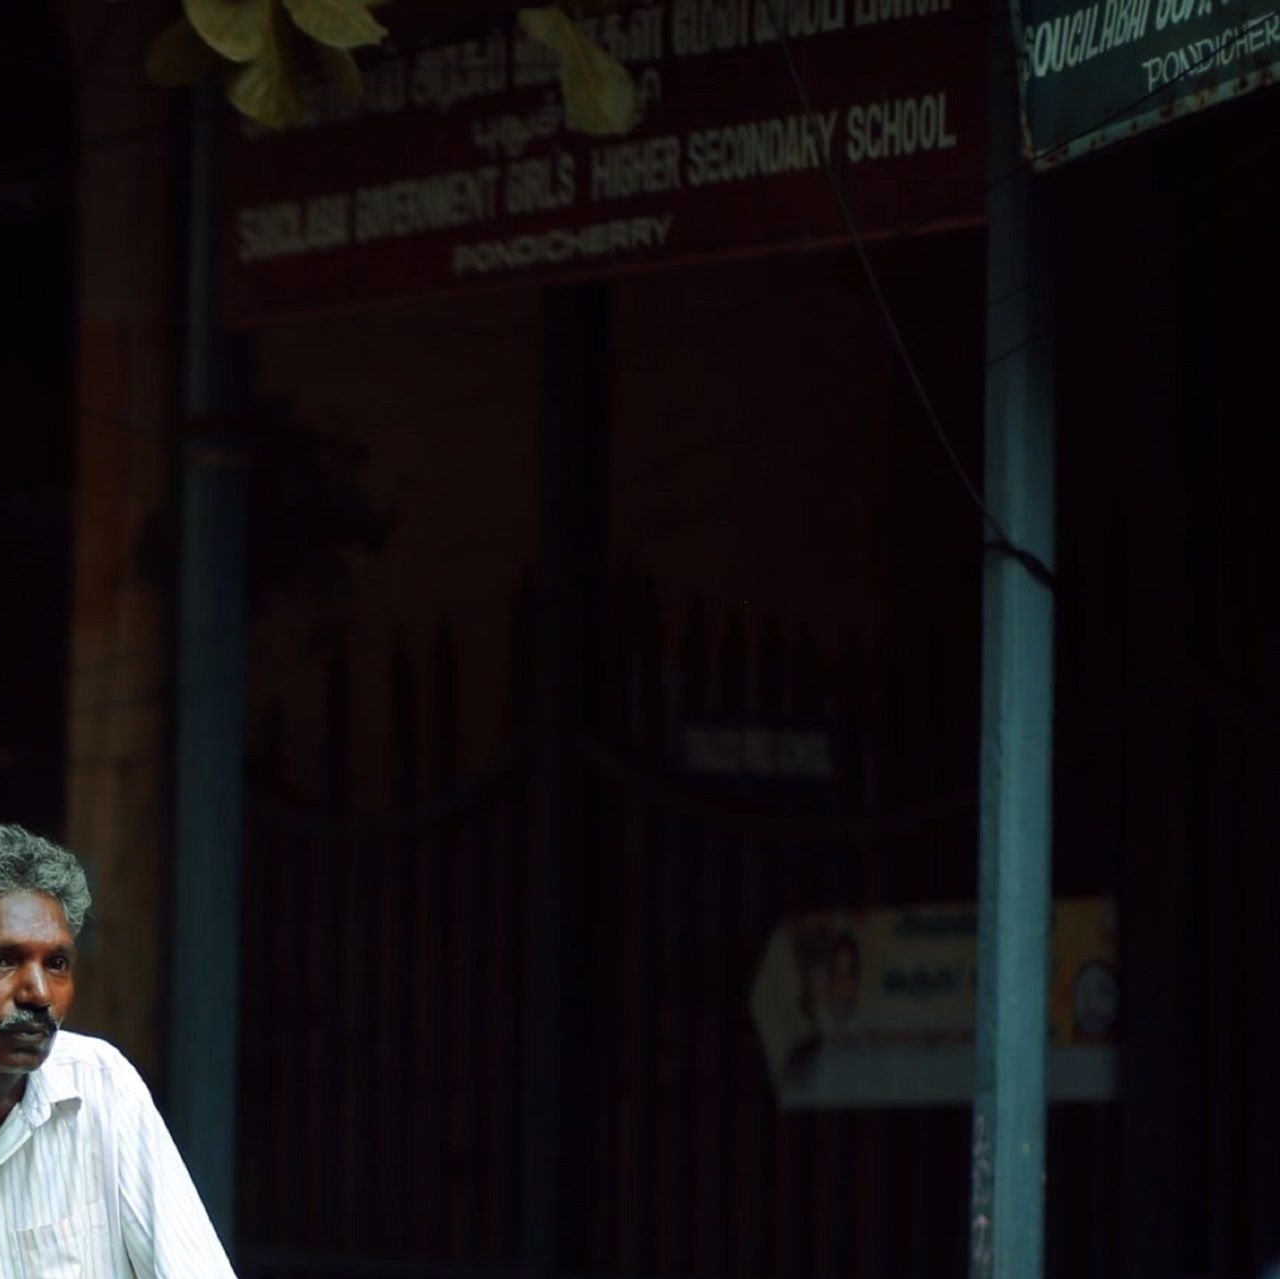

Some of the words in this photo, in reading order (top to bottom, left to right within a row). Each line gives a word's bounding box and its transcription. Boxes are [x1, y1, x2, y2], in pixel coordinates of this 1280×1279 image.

[1022, 0, 1150, 78] SOUCILABAI
[353, 164, 499, 245] GOVERNMENT
[590, 134, 679, 203] HIGHER
[686, 106, 837, 188] SECONDARY
[845, 90, 958, 164] SCHOOL
[450, 213, 672, 277] PONDICHERRY
